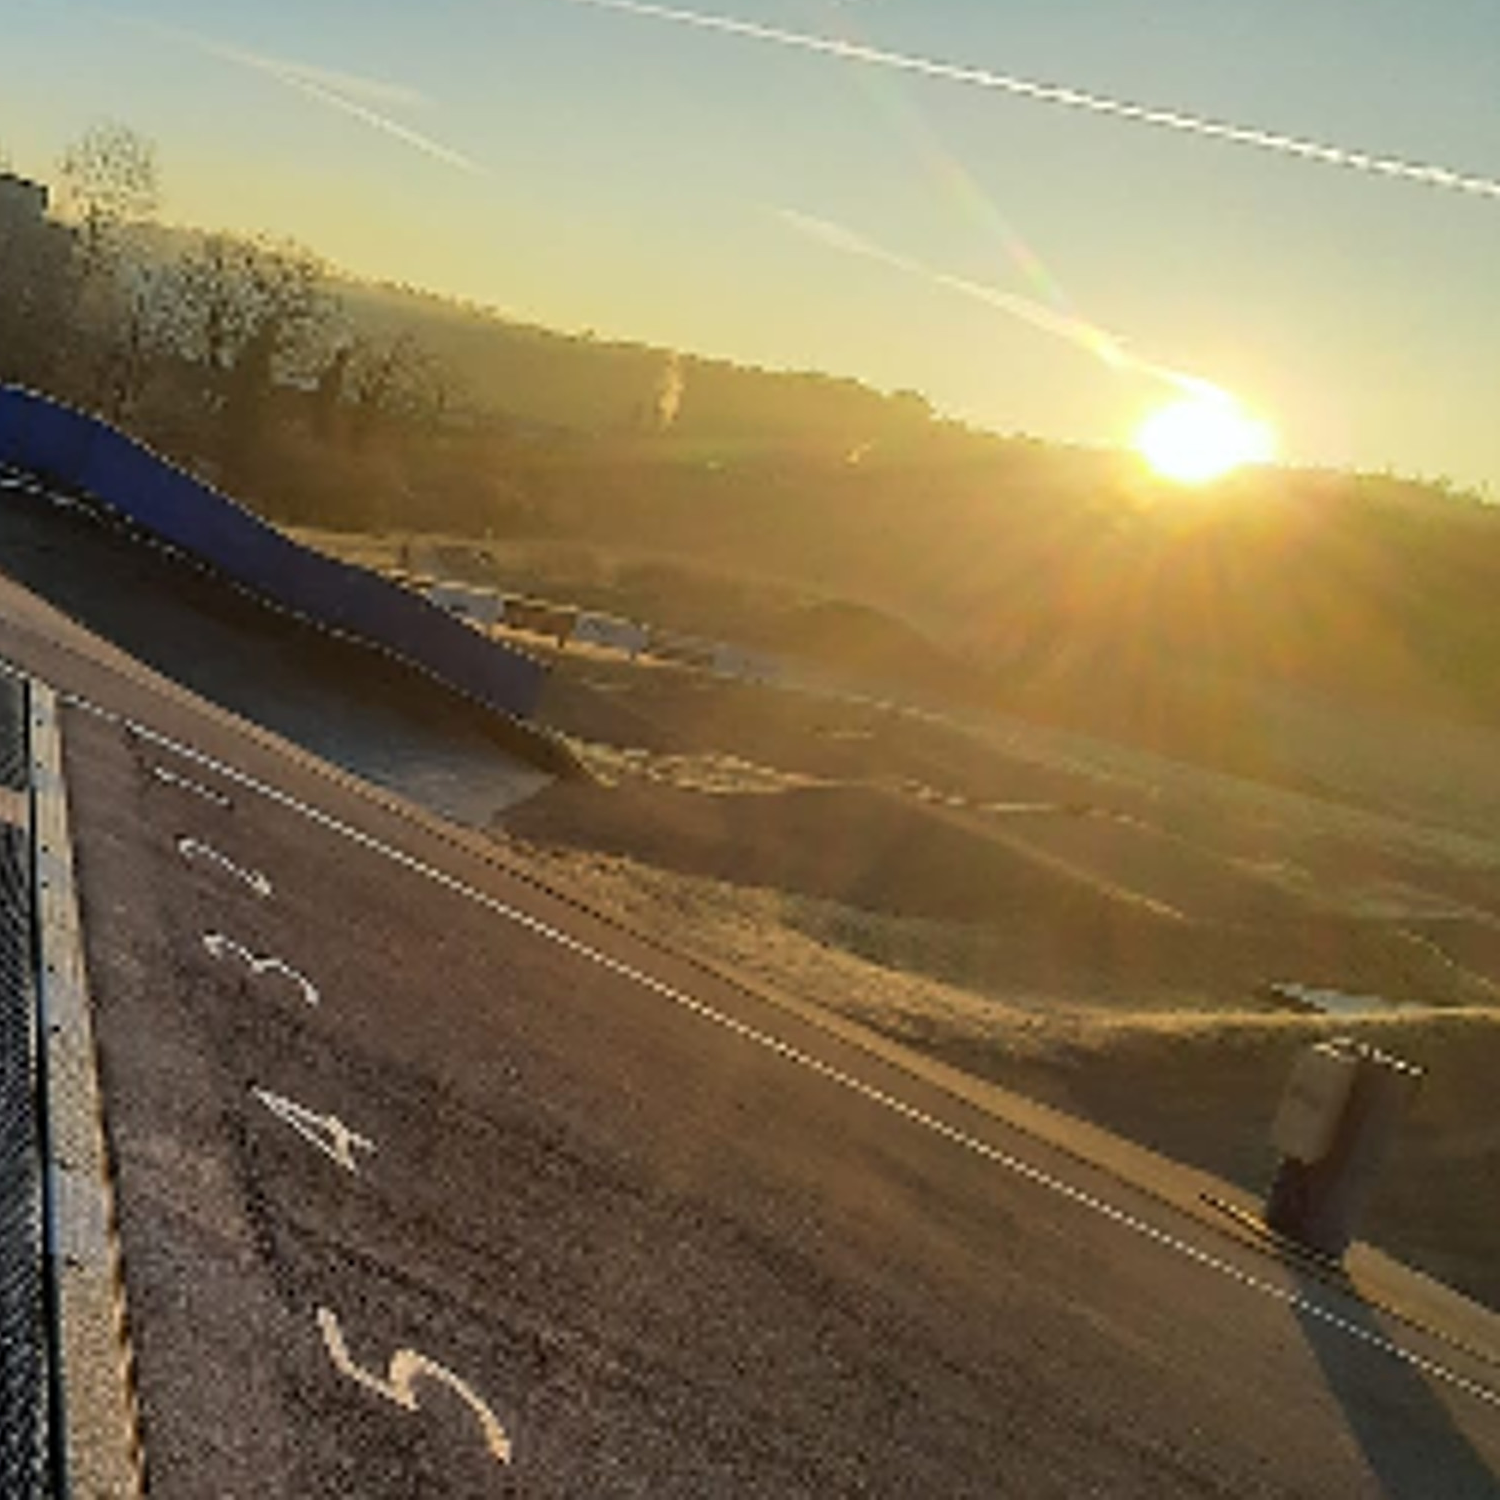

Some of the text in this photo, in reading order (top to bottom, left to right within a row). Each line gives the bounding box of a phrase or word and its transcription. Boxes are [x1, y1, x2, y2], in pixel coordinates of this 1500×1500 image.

[202, 932, 321, 1006] 3
[249, 1084, 380, 1174] 4
[317, 1305, 513, 1465] 5
